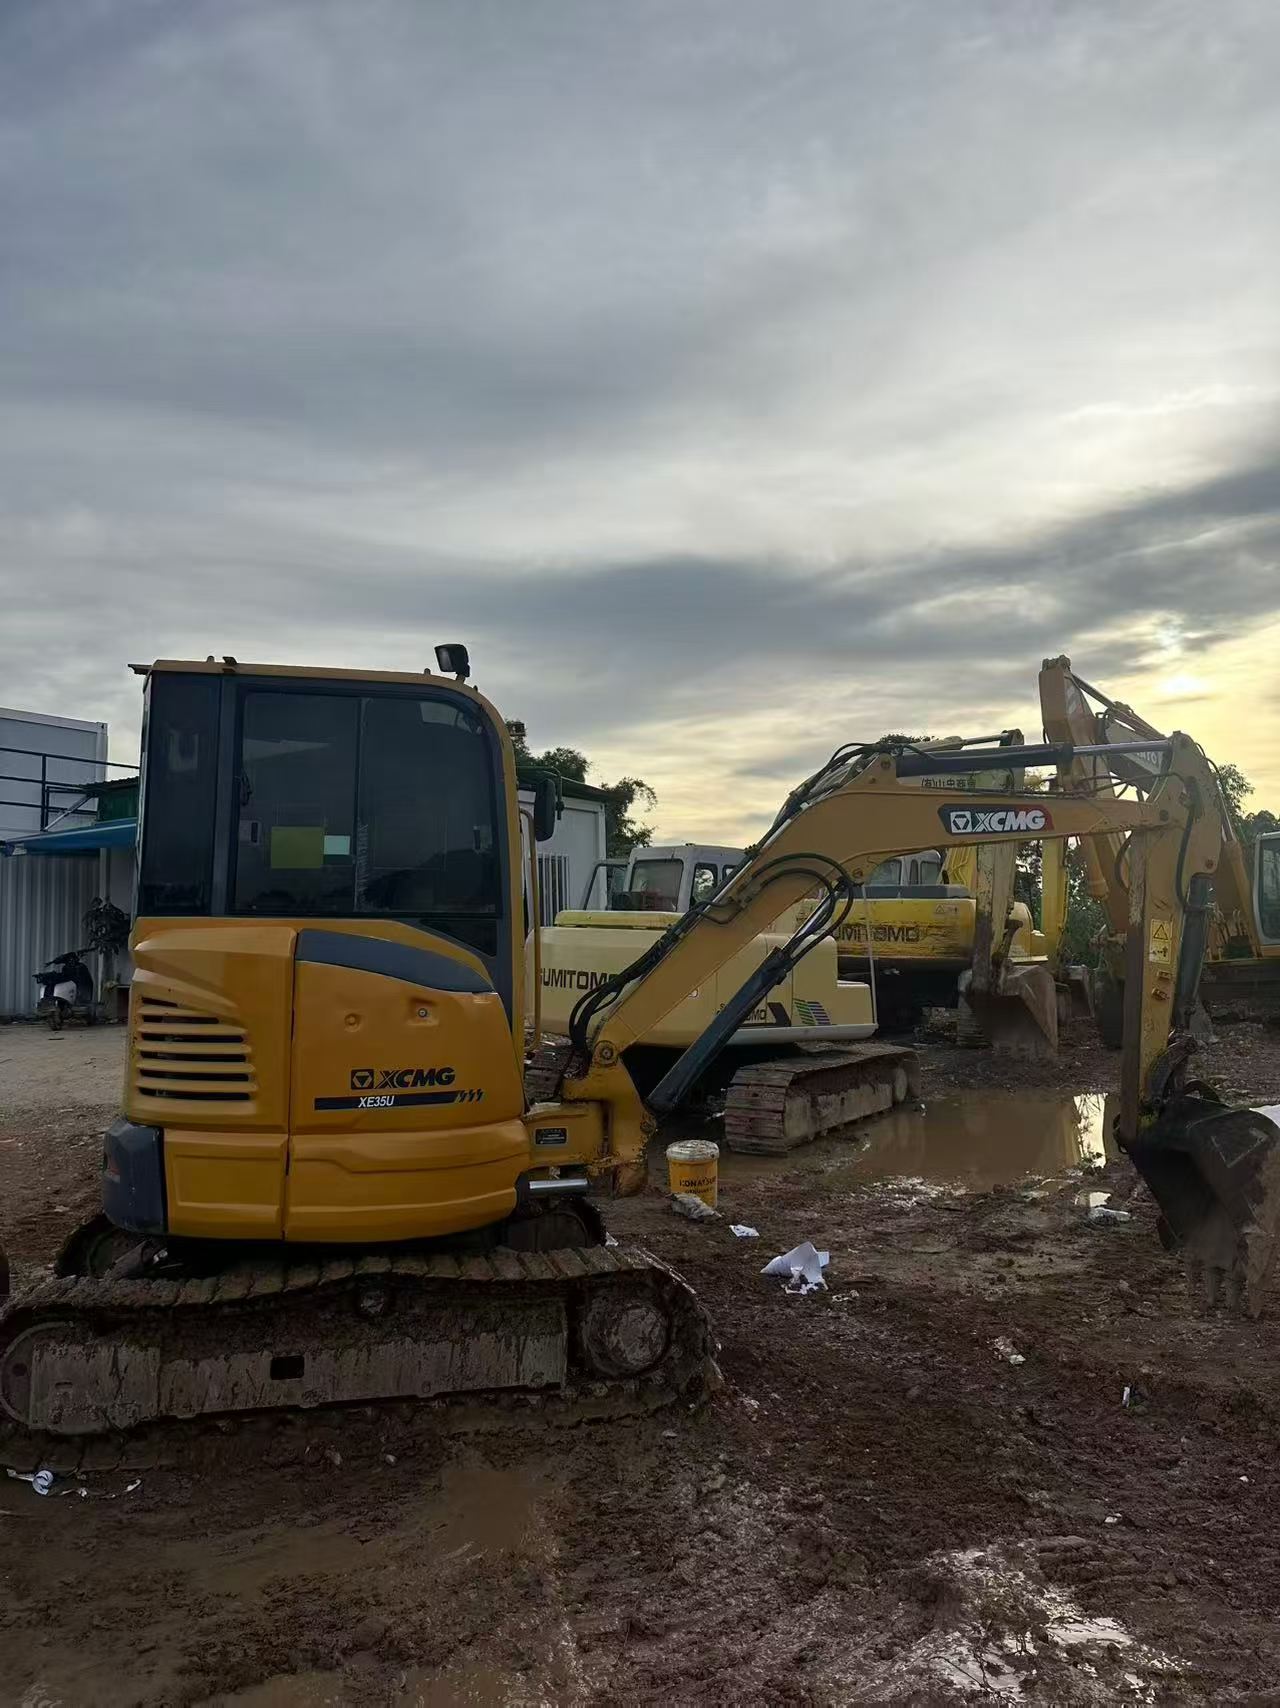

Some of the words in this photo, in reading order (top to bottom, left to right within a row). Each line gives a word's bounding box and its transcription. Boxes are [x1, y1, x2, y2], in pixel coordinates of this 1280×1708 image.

[973, 810, 1045, 832] XCMG
[375, 1067, 456, 1089] XCMG
[358, 1096, 395, 1108] XE35U
